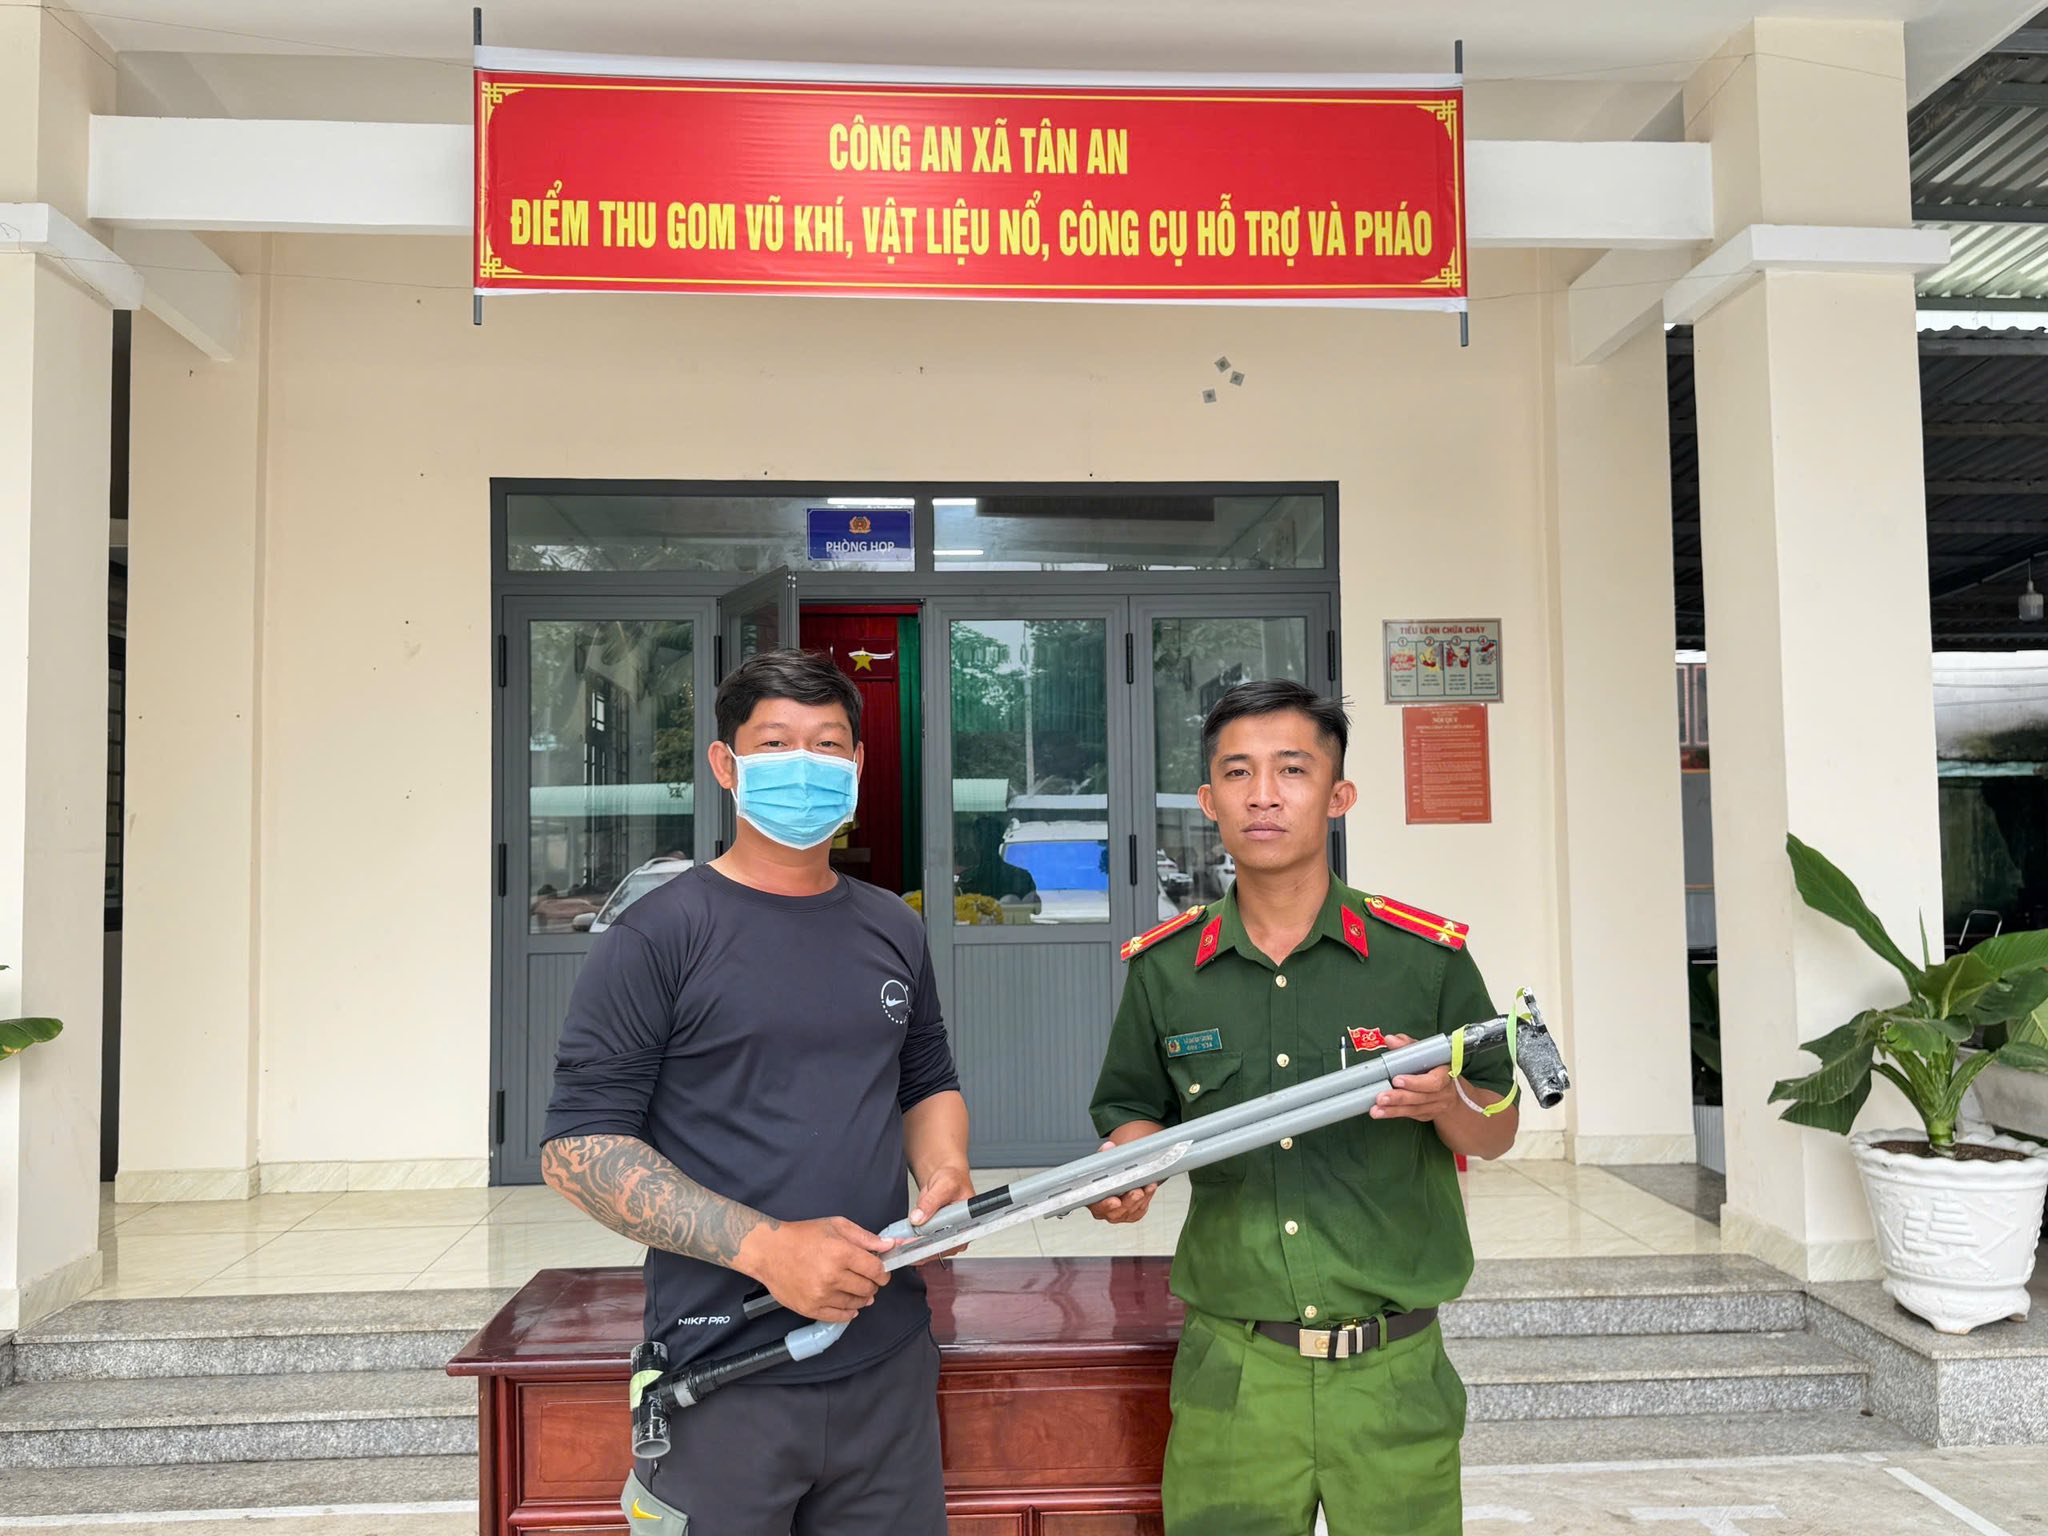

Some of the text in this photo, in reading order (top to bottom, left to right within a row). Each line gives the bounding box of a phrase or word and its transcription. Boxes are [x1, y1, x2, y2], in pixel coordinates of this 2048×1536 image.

[829, 114, 1128, 174] CÔNG AN XÃ TÂN AN
[511, 180, 1432, 266] ĐIỂM THU GOM VŨ KHÍ, VẬT LIỆU NỔ, CÔNG CỤ HỖ TRỢ VÀ PHÁO
[826, 538, 895, 555] PHÒNG HỌP
[708, 1315, 731, 1325] PRO
